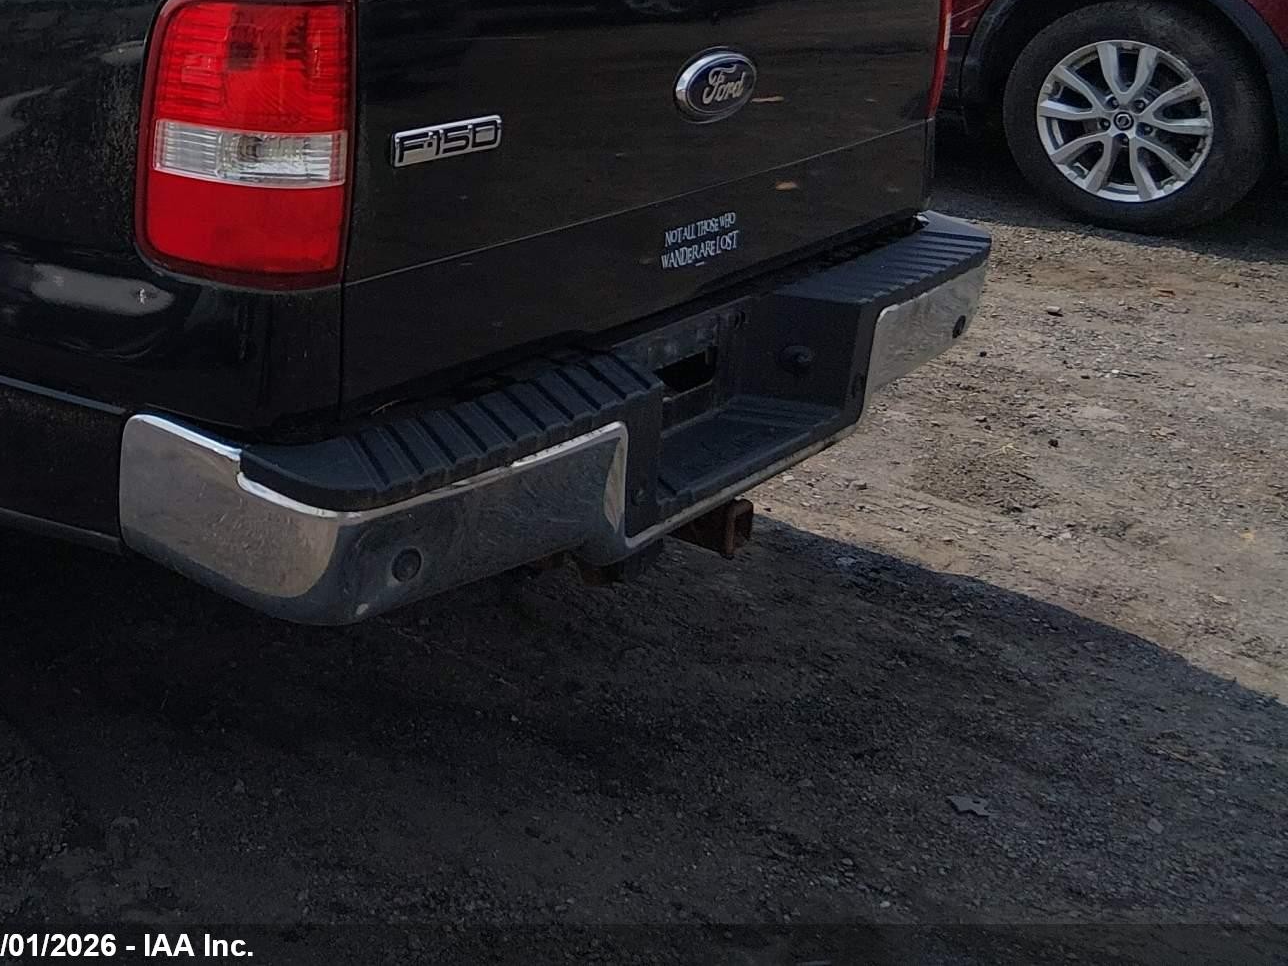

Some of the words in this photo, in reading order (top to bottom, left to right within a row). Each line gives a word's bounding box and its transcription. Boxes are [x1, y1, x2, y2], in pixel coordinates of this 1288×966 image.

[702, 63, 747, 105] Ford
[665, 228, 683, 247] NOT
[682, 223, 696, 240] ALL
[696, 218, 719, 237] THOSE
[719, 212, 736, 228] WHO
[661, 245, 699, 269] WANDER
[699, 240, 716, 258] ARE
[715, 231, 739, 254] LOST
